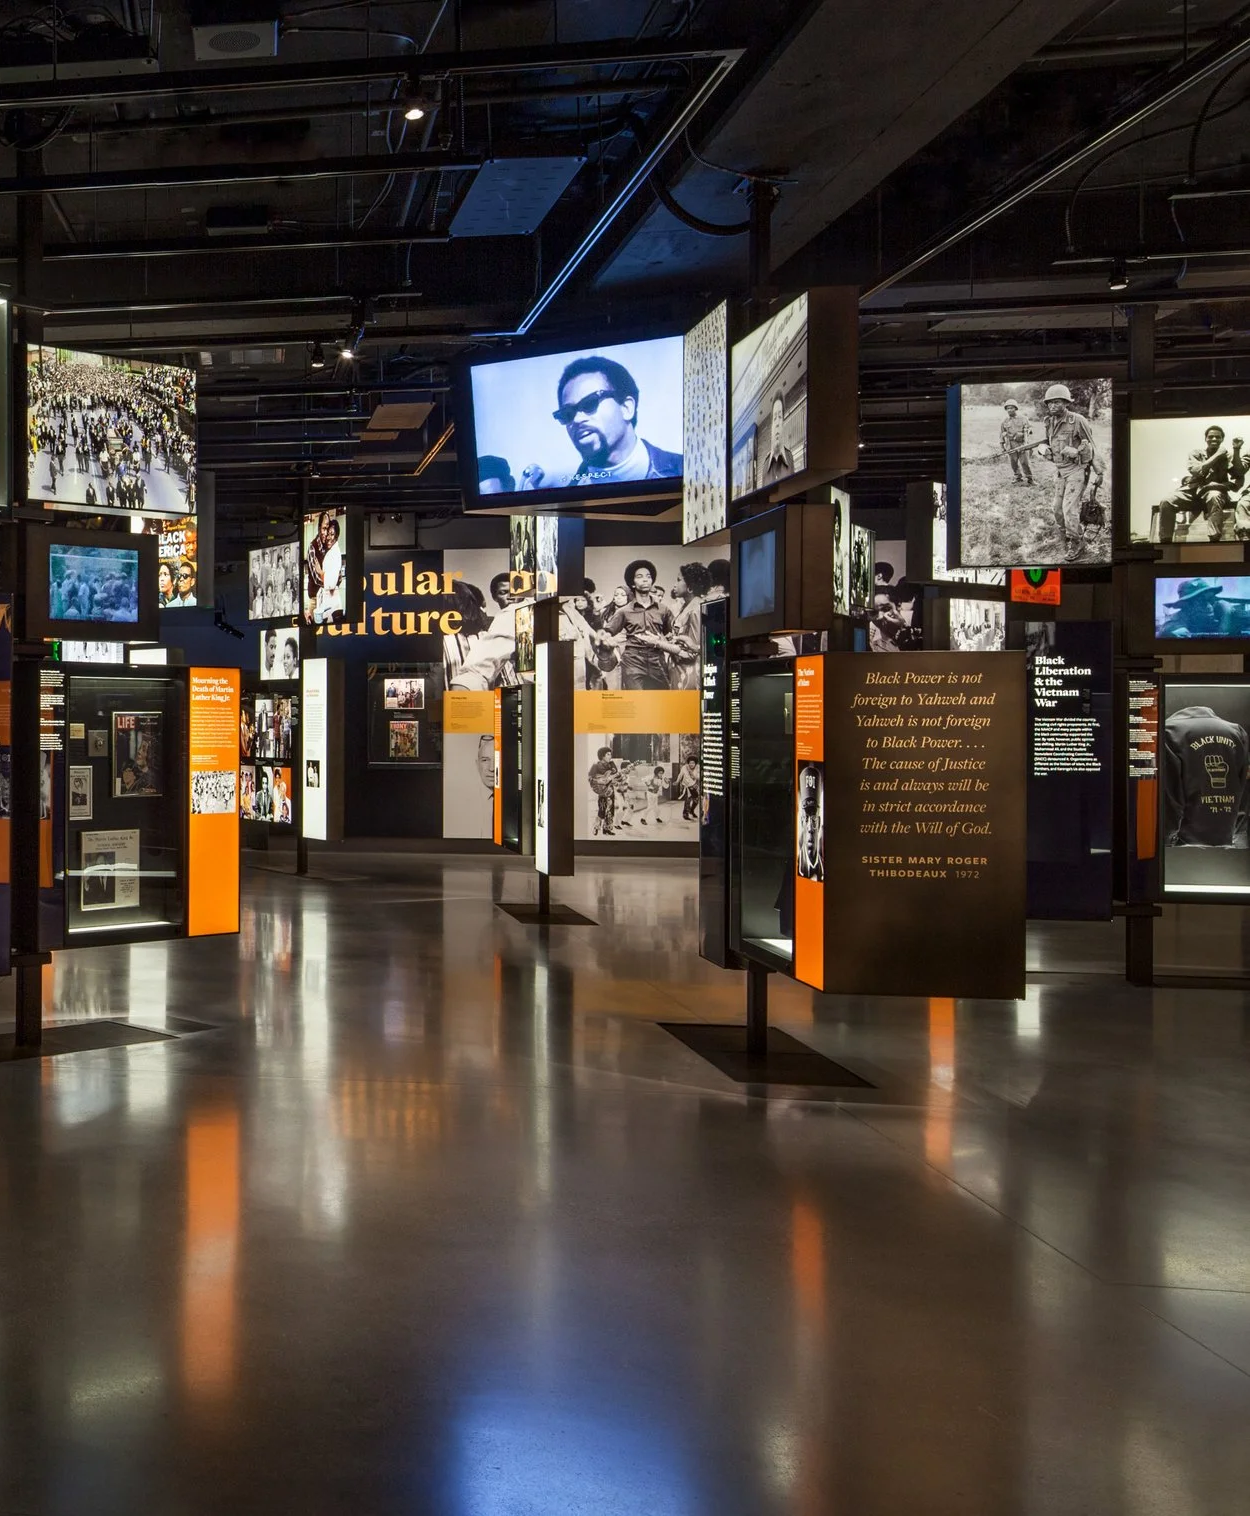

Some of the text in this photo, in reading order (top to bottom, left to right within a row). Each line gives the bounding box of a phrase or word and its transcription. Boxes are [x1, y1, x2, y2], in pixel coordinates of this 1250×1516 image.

[1035, 656, 1065, 665] Black
[1035, 666, 1092, 676] Liberation
[192, 677, 228, 686] Mourning the
[865, 672, 983, 684] Black Power is not
[1034, 677, 1063, 686] & the
[215, 685, 234, 693] Martin
[1034, 687, 1080, 697] Vietnam
[211, 694, 223, 702] King
[851, 692, 996, 709] foreign to Yahweh and
[1034, 698, 1058, 707] War
[117, 716, 135, 729] LIFE
[856, 714, 991, 730] Yahweh is not foreign
[1190, 735, 1237, 751] BLACK UNITY
[1200, 795, 1235, 805] VIETNAM
[861, 856, 988, 865] SISTER MARY ROGER
[869, 869, 980, 879] THIBODEAUX 1972
